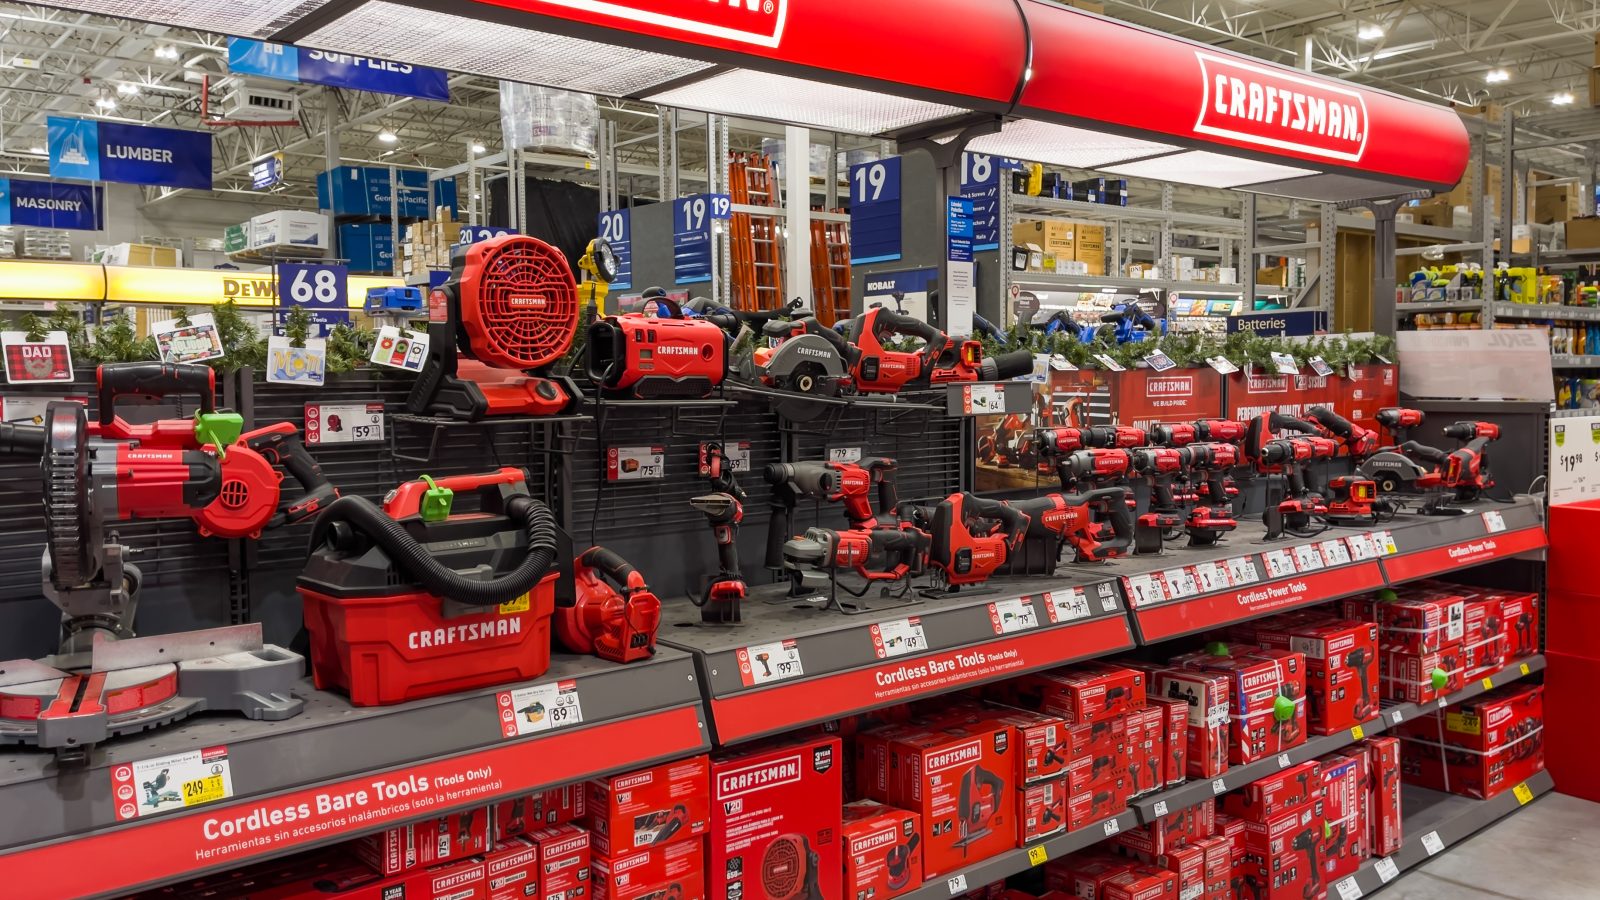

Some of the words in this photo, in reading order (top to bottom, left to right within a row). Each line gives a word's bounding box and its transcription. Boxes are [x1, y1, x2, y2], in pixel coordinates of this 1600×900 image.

[1215, 74, 1358, 141] CRAFTSMAN
[106, 144, 173, 164] LUMBER
[961, 154, 992, 185] 18
[855, 164, 886, 202] 19
[16, 197, 82, 212] MASONRY
[711, 197, 730, 216] 19
[683, 199, 706, 231] 19
[601, 213, 624, 241] 20
[460, 229, 473, 244] 20
[290, 269, 338, 303] 68
[867, 280, 896, 291] KOBALT
[511, 297, 546, 306] CRAFTSMAN
[1237, 317, 1286, 331] Batteries
[22, 346, 52, 359] DAD
[657, 346, 699, 355] CRAFTSMAN
[797, 347, 831, 359] CRAFTSMAN
[1150, 381, 1191, 392] CRAFTSMAN
[1250, 377, 1287, 389] CRAFTSMAN
[990, 402, 999, 411] 64
[355, 426, 370, 438] 59
[643, 466, 654, 476] 75
[1045, 512, 1078, 523] CRAFTSMAN
[972, 552, 995, 560] CRAFTSMAN
[1237, 591, 1268, 605] Cordless
[1267, 586, 1289, 598] Power
[1288, 581, 1307, 593] Tools
[408, 617, 521, 650] CRAFTSMAN
[907, 638, 917, 648] 49
[780, 663, 792, 674] 99
[876, 665, 927, 686] Cordless
[928, 658, 956, 675] Bare
[956, 652, 985, 668] Tools
[875, 686, 911, 698] Herramientas
[553, 707, 568, 721] 89
[929, 744, 978, 769] CRAFTSMAN
[617, 775, 650, 789] CRAFTSMAN
[722, 763, 796, 792] CRAFTSMAN
[203, 803, 311, 840] Cordless
[315, 790, 368, 815] Bare
[372, 775, 429, 800] Tools
[434, 775, 465, 789] (Tools
[466, 766, 492, 781] Only)
[724, 799, 742, 815] V20
[195, 836, 272, 860] Herramientas
[274, 830, 290, 841] sin
[292, 816, 346, 837] accesorios
[348, 803, 410, 823] inalámbricos
[412, 797, 434, 809] (solo
[435, 793, 444, 802] la
[446, 779, 503, 799] herramienta)
[389, 829, 398, 869] CRAFTSM
[547, 838, 586, 856] CRAFTSMAN
[854, 832, 895, 852] CRAFTSMAN
[1029, 850, 1038, 858] 99
[491, 853, 534, 872] CRAFTSMAN
[615, 855, 647, 871] CRAFTSMAN
[436, 870, 482, 890] CRAFTSMAN
[950, 878, 960, 889] 79
